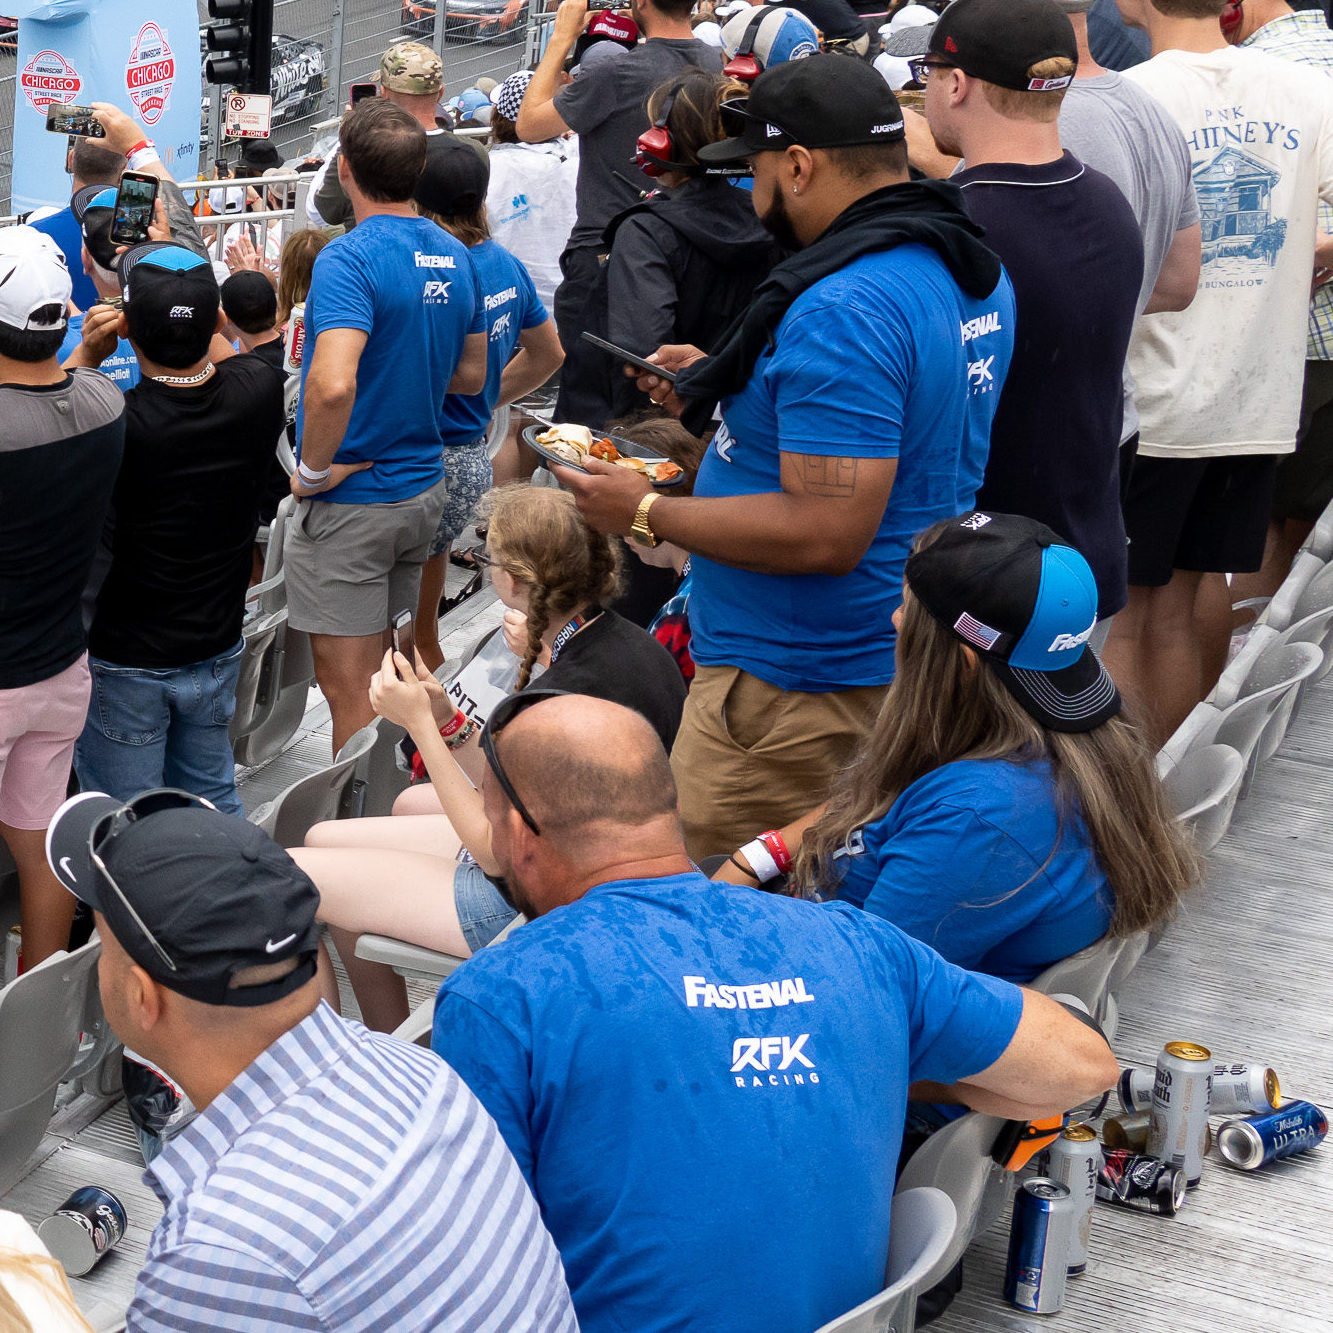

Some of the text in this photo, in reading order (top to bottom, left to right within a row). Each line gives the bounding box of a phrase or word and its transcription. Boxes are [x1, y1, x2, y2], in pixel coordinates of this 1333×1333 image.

[25, 76, 75, 90] CHICAGO
[131, 64, 172, 86] CHICAGO
[141, 97, 162, 113] WEEKEND
[176, 142, 195, 159] xfinity
[414, 251, 457, 269] FASTENAL
[1205, 278, 1263, 288] BUNGALOW
[484, 286, 518, 311] FASTENAL
[169, 306, 195, 315] RFK
[294, 326, 305, 360] ARTOIS
[683, 975, 815, 1010] FASTENAL
[729, 1034, 816, 1072] RFK
[735, 1073, 820, 1088] RACING
[1273, 1125, 1314, 1150] ULTRA
